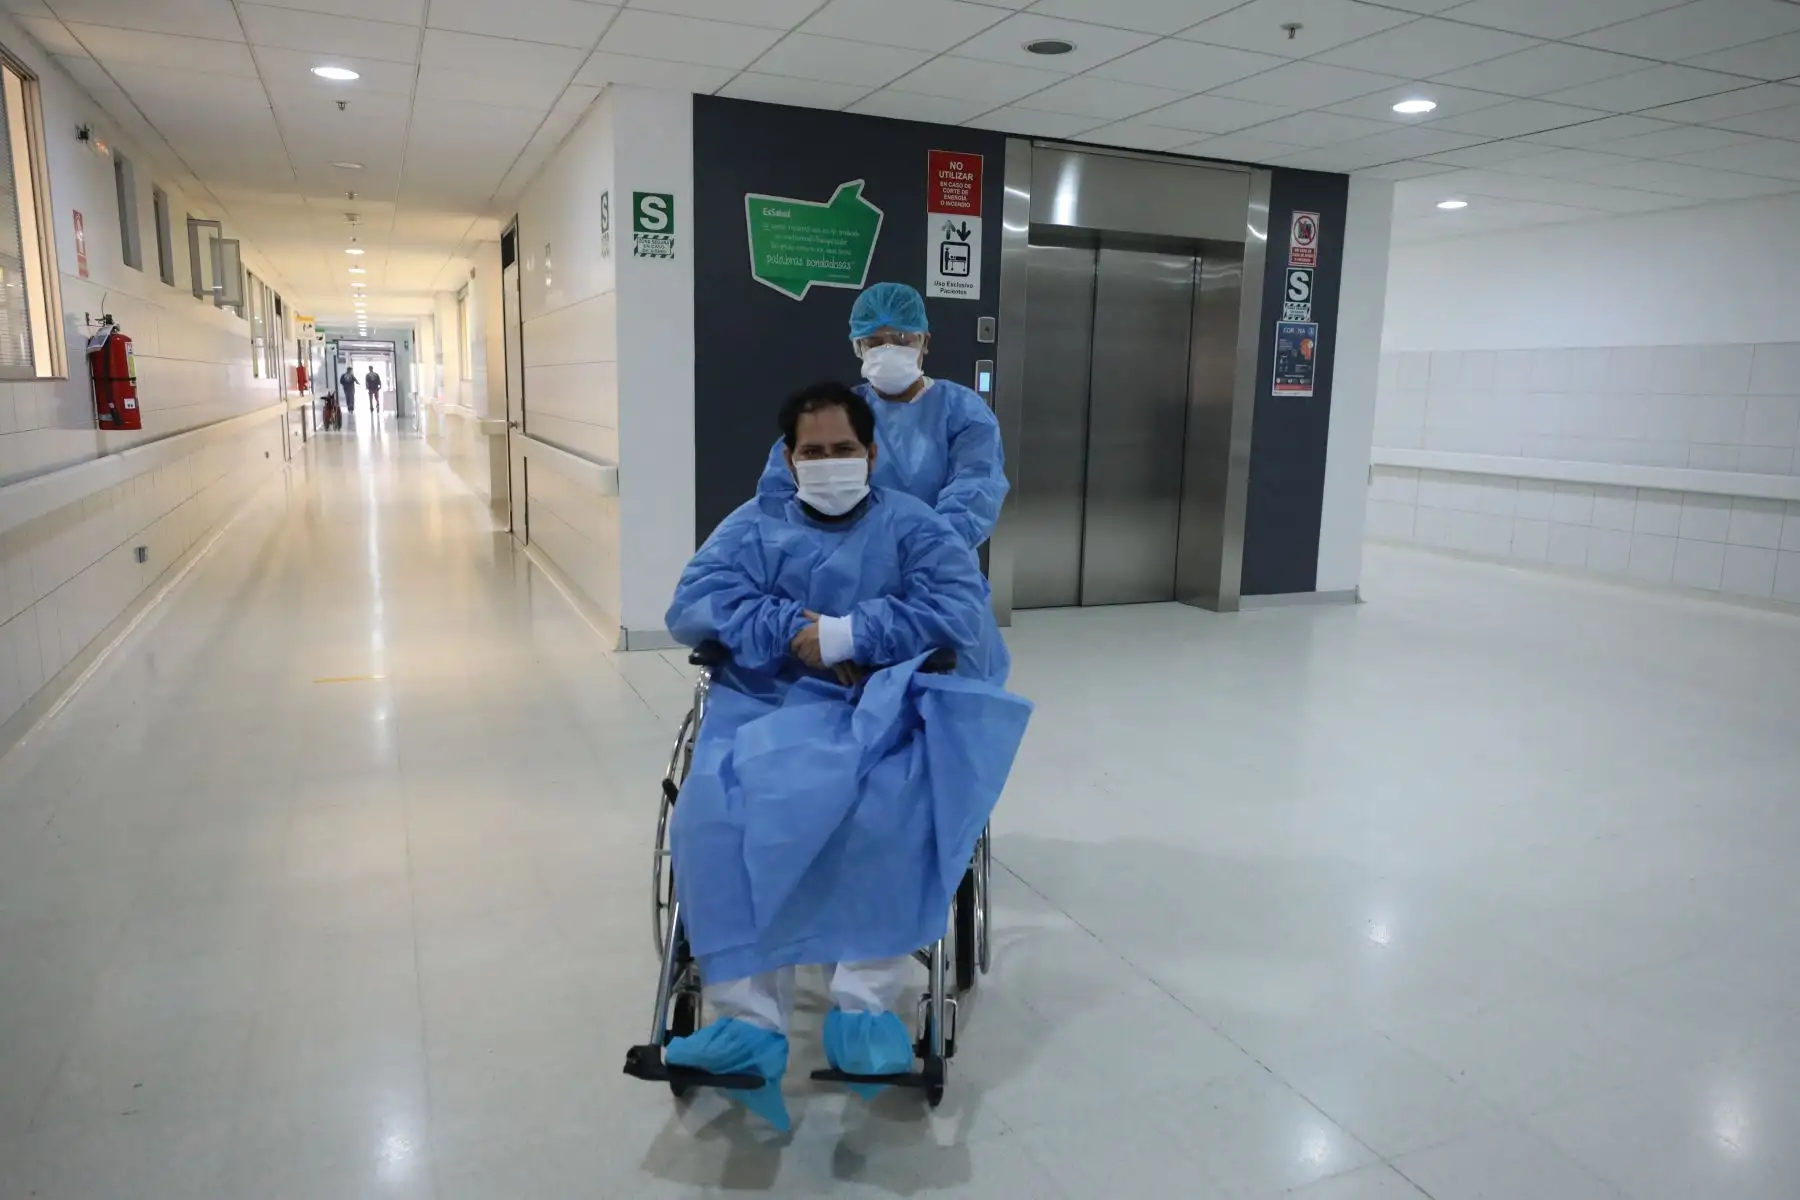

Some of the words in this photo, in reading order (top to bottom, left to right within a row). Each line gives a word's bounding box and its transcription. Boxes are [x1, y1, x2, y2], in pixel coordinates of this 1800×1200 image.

[949, 161, 964, 171] NO
[939, 170, 974, 181] UTILIZAR
[639, 195, 669, 231] S
[946, 281, 974, 289] Exclusivo
[1287, 271, 1309, 301] S
